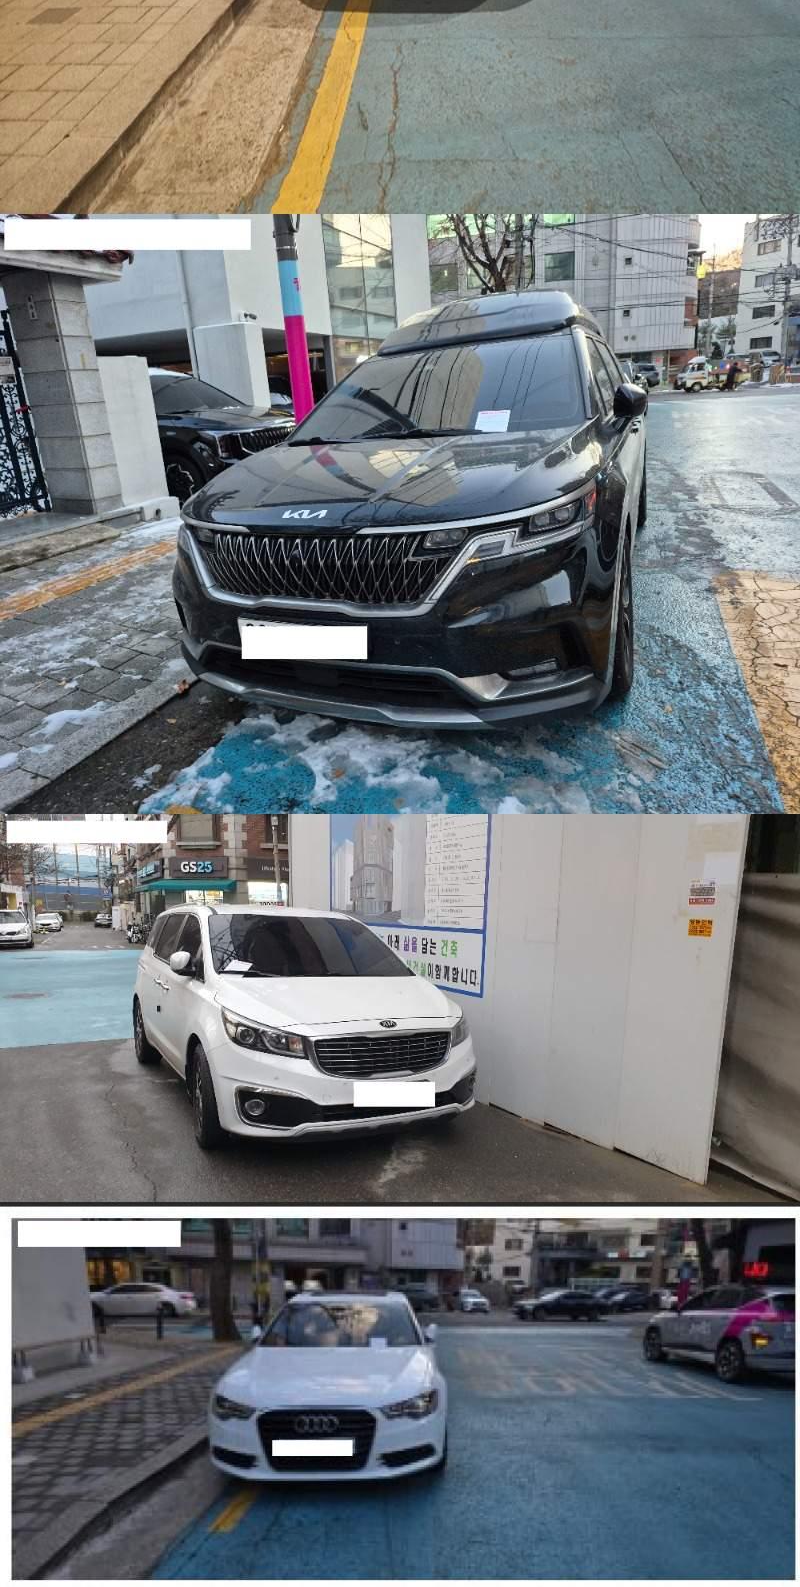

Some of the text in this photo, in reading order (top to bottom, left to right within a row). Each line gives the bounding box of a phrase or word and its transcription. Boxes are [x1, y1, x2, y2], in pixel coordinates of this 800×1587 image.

[281, 509, 328, 519] KIA
[180, 861, 214, 873] GS25
[387, 934, 458, 958] 아래 삶을 담는 건축
